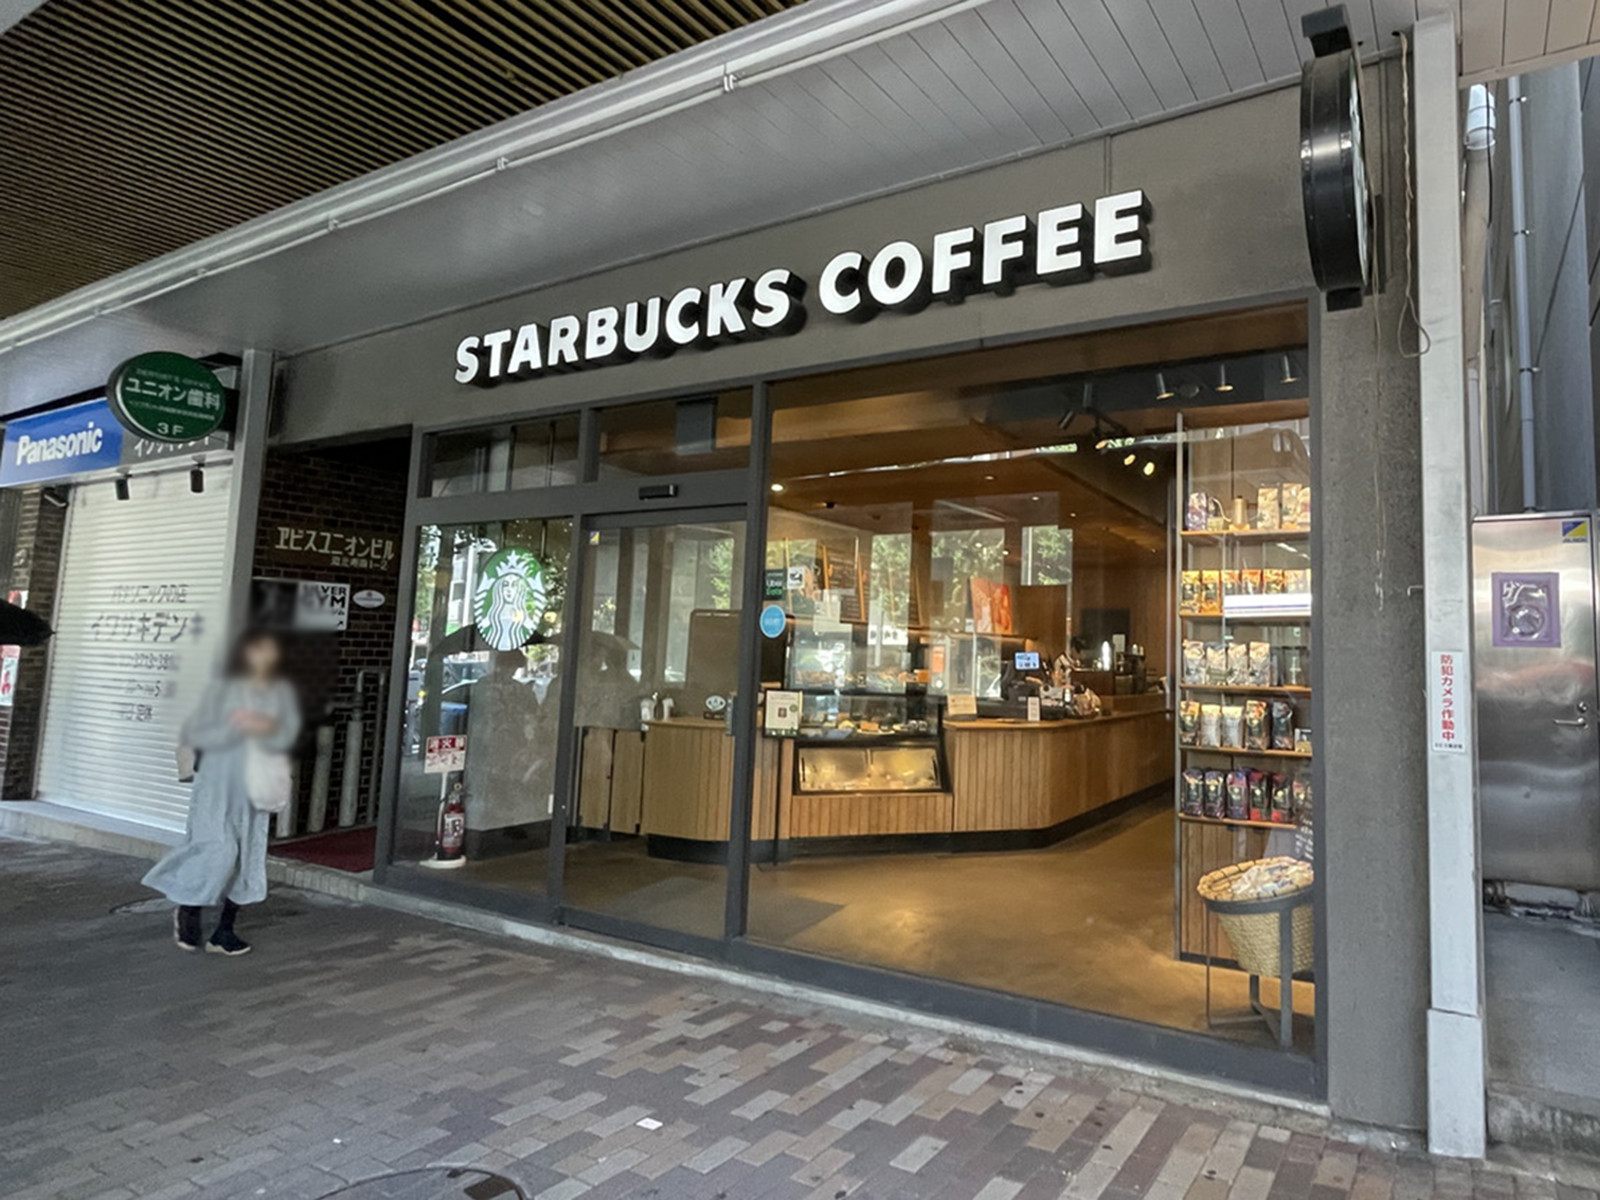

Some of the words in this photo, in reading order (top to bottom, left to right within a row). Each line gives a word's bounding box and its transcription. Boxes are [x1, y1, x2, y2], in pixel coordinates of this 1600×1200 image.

[454, 268, 794, 385] STARBUCKS
[818, 189, 1144, 315] COFFEE
[125, 377, 220, 411] ユニオン歯科
[16, 421, 103, 466] Panasonic
[156, 422, 184, 436] 3F
[1441, 654, 1455, 741] 防犯カメラ作動中
